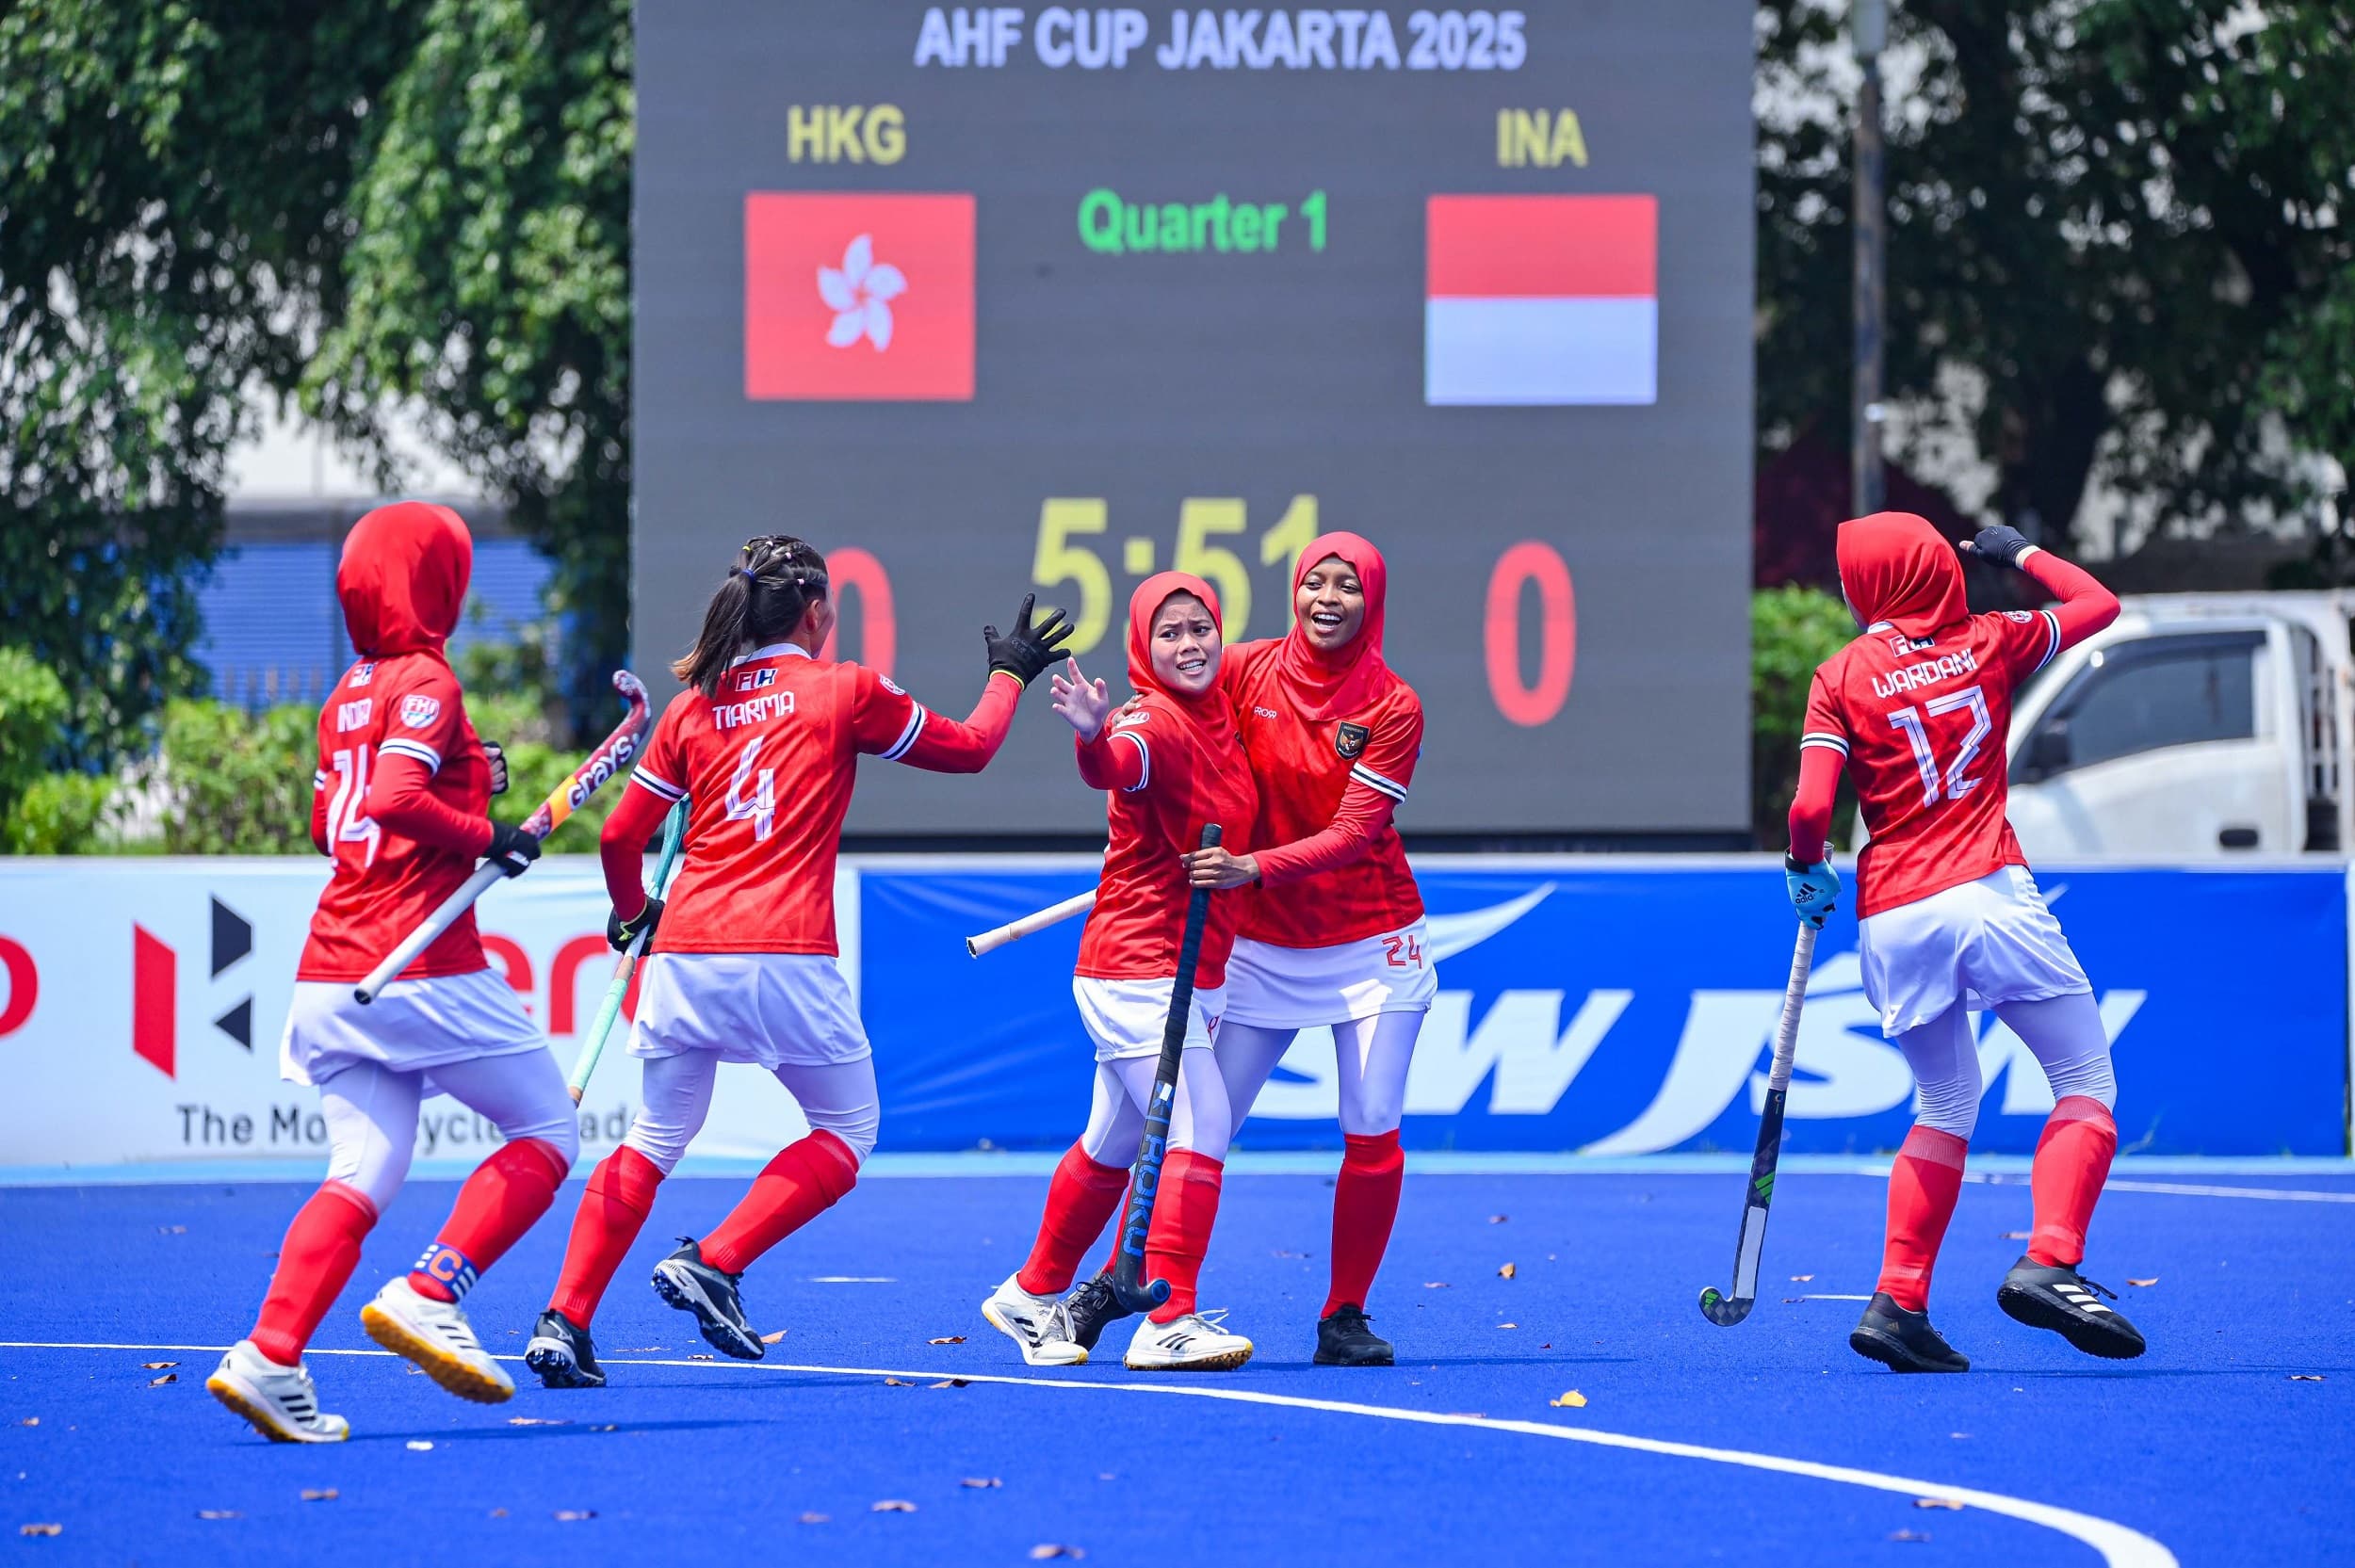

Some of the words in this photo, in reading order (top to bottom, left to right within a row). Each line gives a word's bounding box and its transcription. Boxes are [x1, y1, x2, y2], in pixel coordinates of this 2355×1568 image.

[914, 8, 1024, 68] AHF
[1034, 7, 1148, 69] CUP
[1156, 10, 1401, 70] JAKARTA
[1407, 10, 1528, 70] 2025
[788, 104, 906, 164] HKG
[1496, 107, 1588, 168] INA
[1078, 188, 1287, 254] Quarter
[1301, 190, 1327, 251] 1
[1485, 540, 1577, 726] 0
[1871, 647, 1978, 699] WARDANI
[711, 690, 795, 730] TIARMA
[725, 735, 775, 841] 4
[1382, 934, 1423, 969] 24
[176, 1105, 254, 1145] The
[1122, 1134, 1167, 1258] ROKU
[429, 1249, 463, 1281] C
